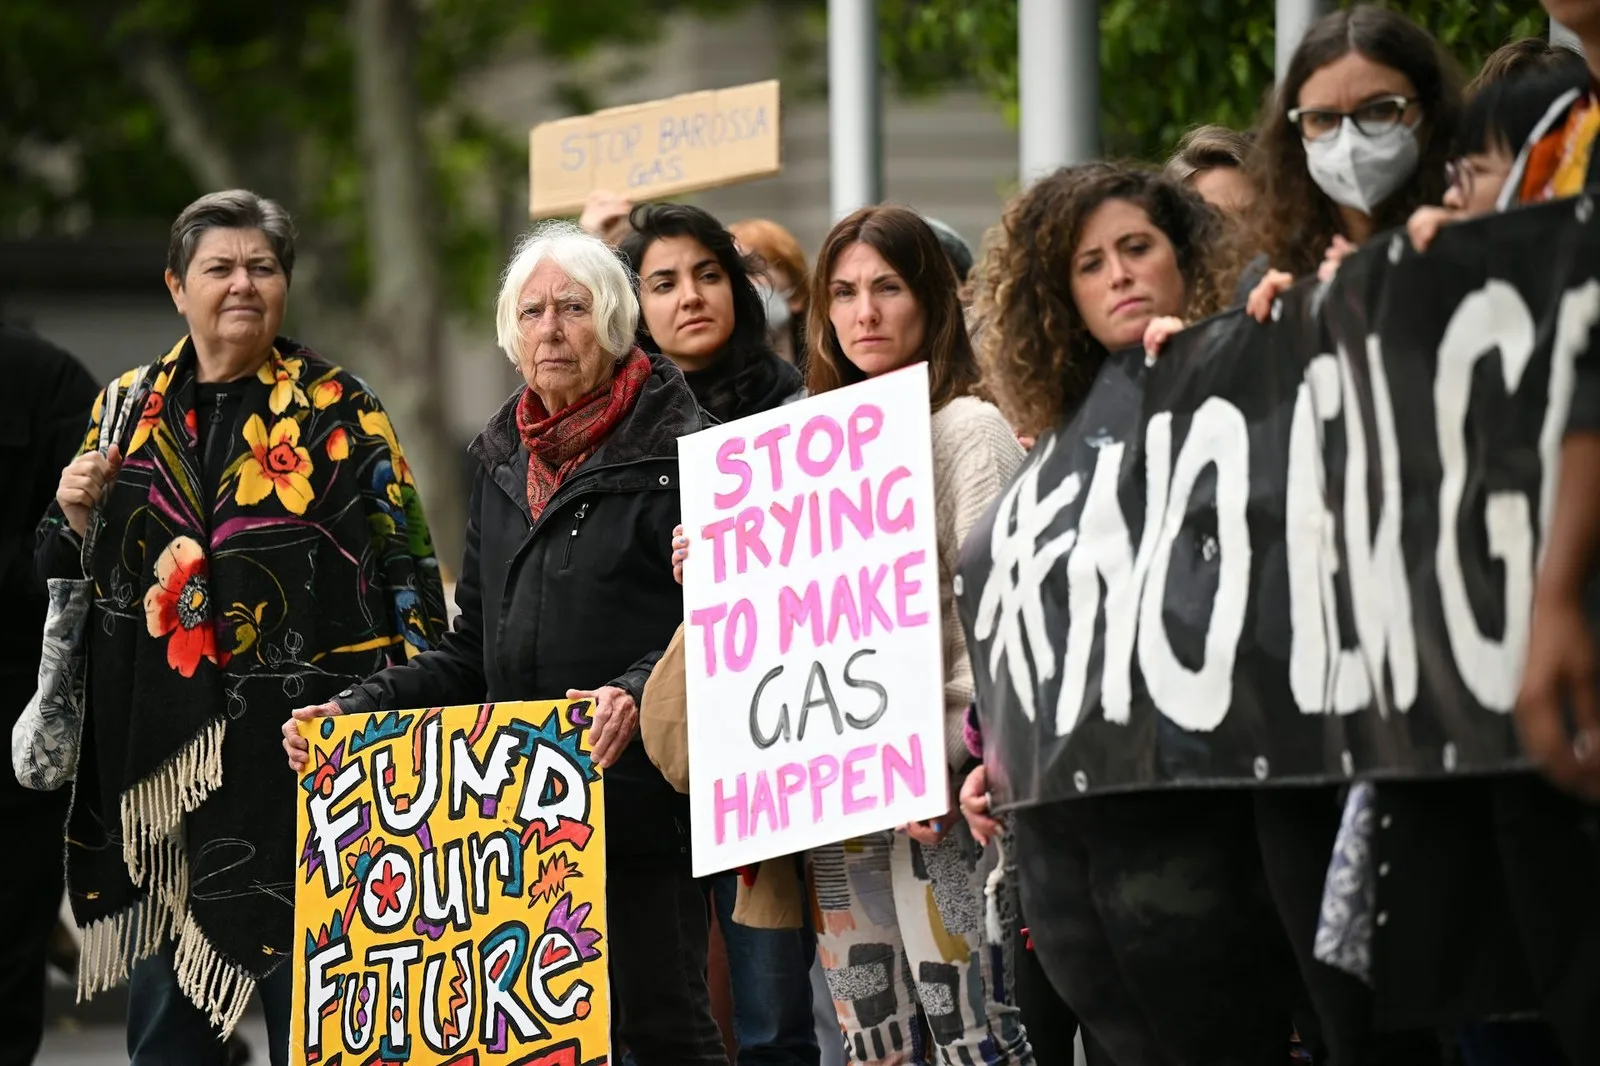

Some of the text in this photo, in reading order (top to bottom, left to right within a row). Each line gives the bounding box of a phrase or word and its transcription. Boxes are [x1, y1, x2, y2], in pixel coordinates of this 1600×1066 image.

[560, 105, 769, 172] STOP BAROSSA
[627, 155, 685, 188] GAS
[714, 404, 884, 510] STOP
[701, 466, 915, 583] TRYING
[691, 549, 929, 678] TO MAKE
[748, 648, 888, 750] GAS
[303, 714, 591, 897] FUND
[714, 734, 927, 845] HAPPEN
